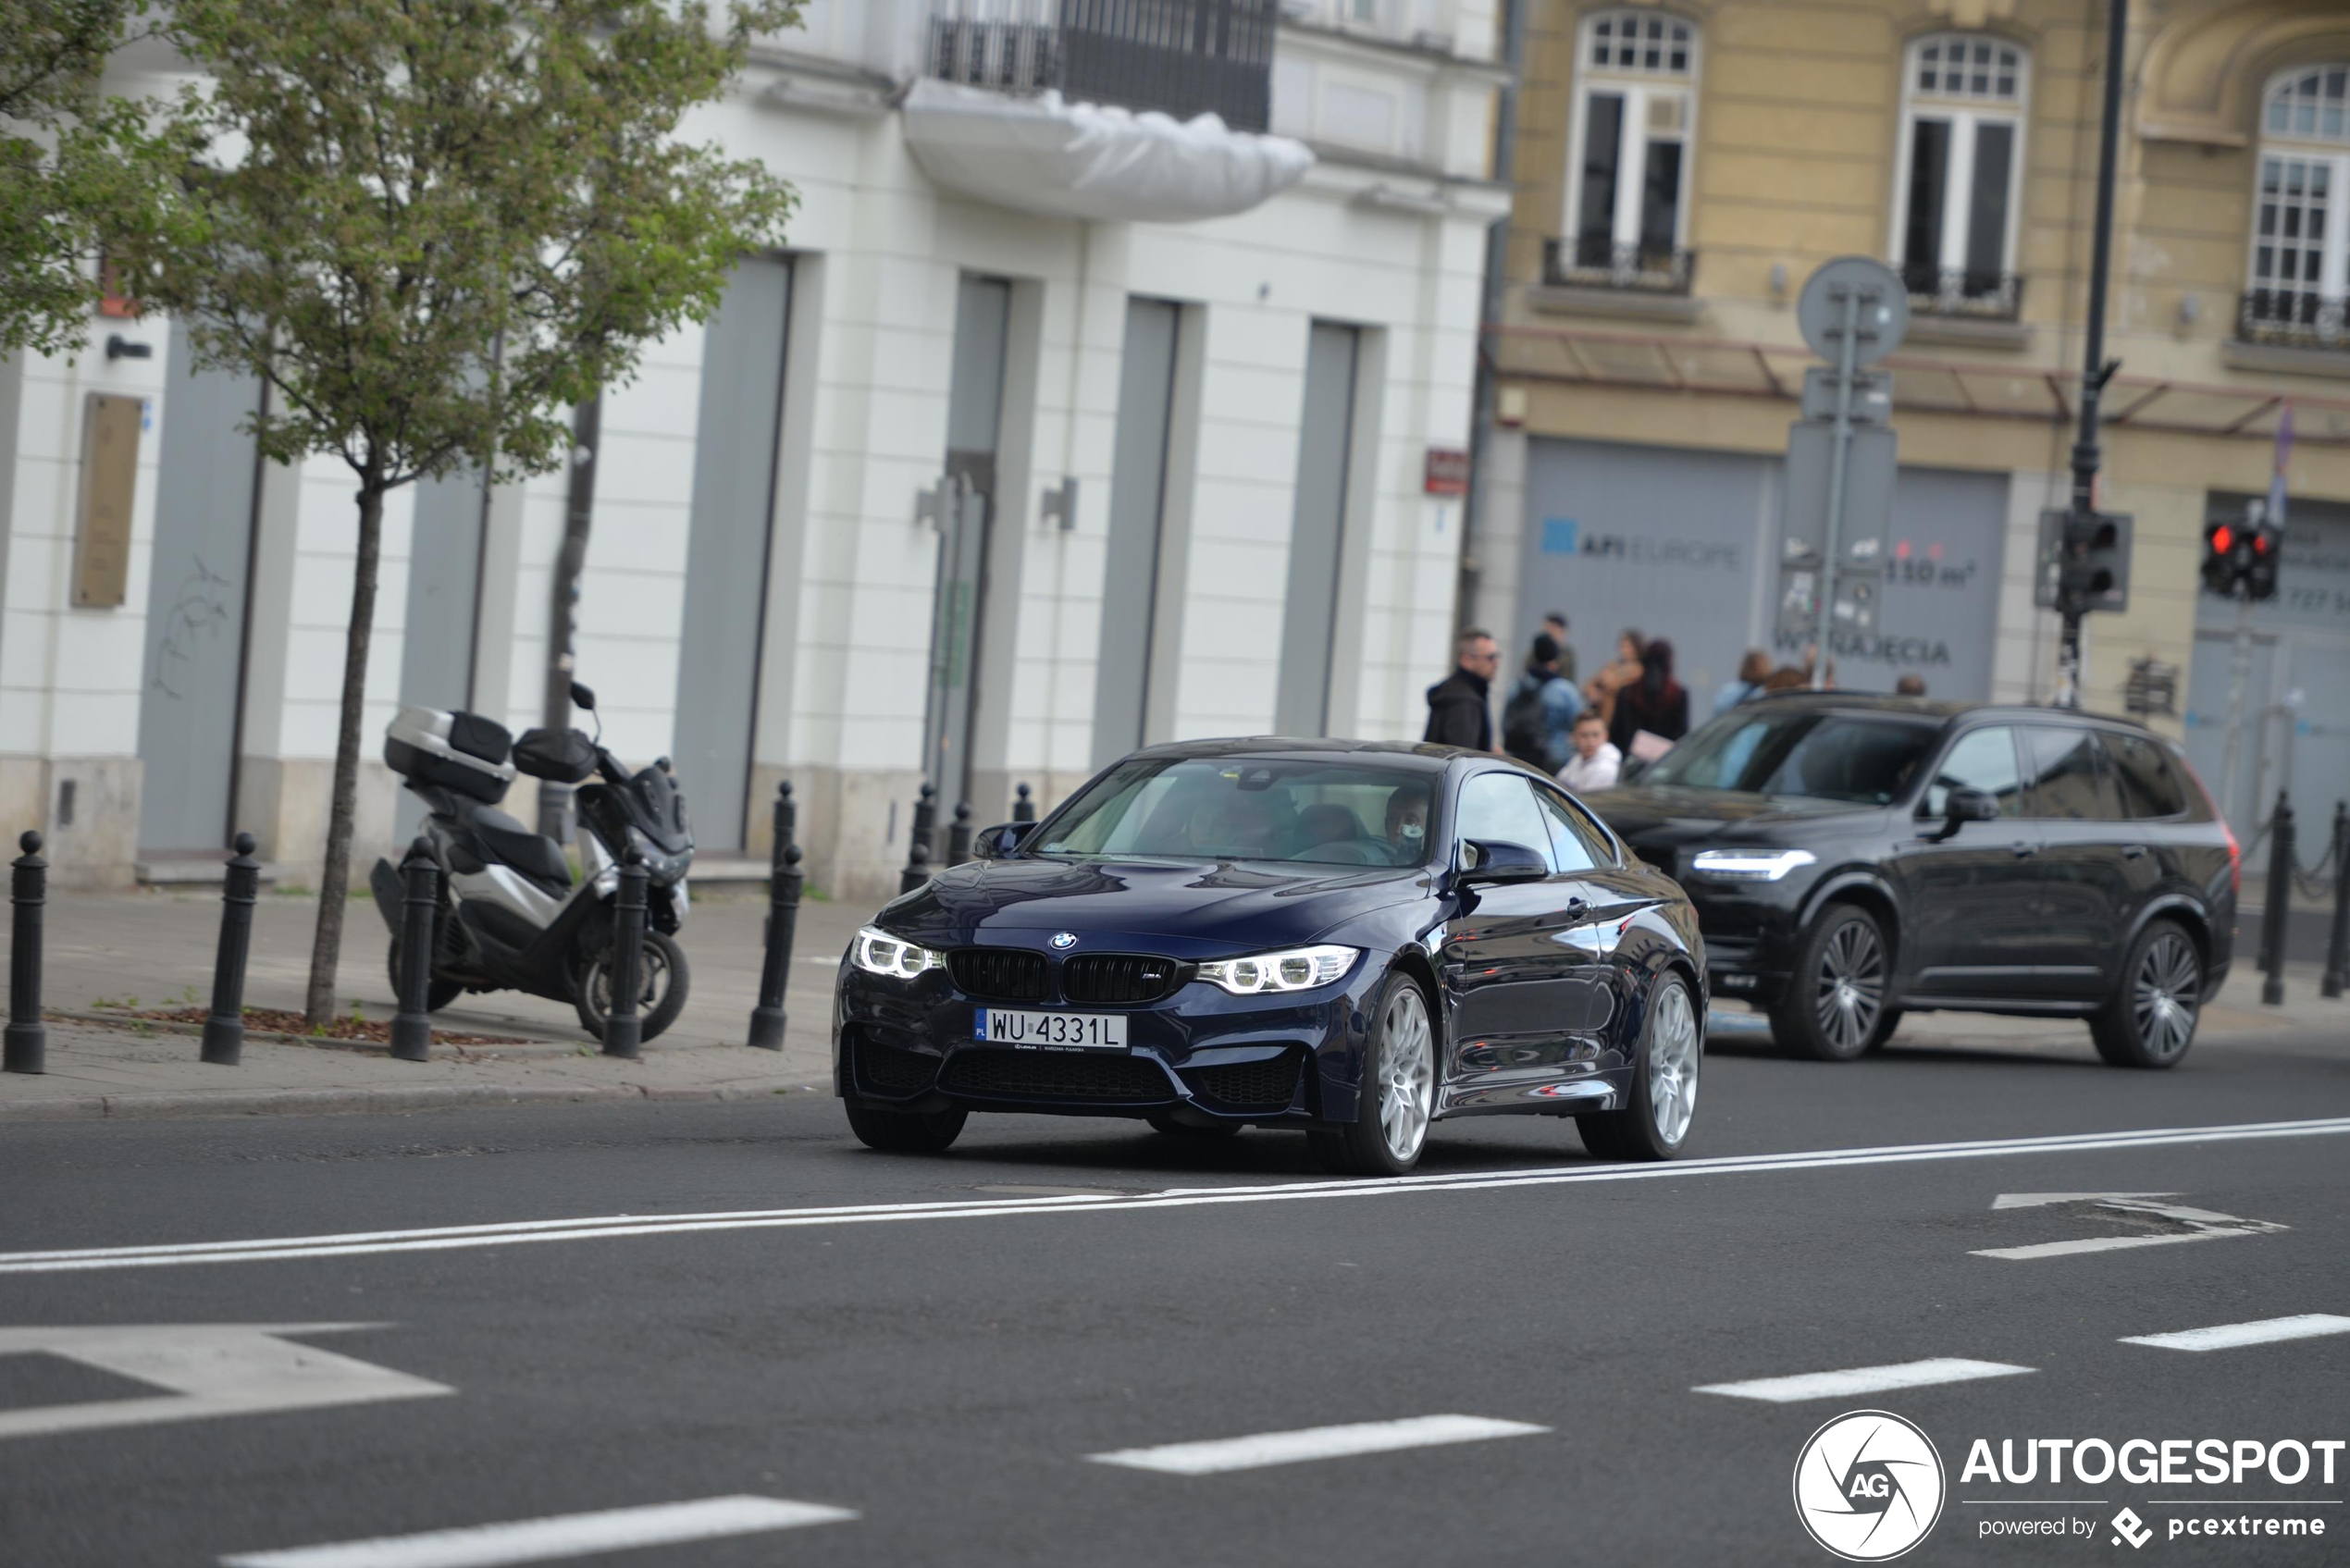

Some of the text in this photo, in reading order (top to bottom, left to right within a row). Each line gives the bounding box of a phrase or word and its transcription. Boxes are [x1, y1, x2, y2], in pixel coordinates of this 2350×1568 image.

[1629, 535, 1742, 572] EUROPE
[1886, 557, 1935, 585] 110
[976, 1028, 985, 1036] PL
[993, 1012, 1119, 1045] WU 4331L
